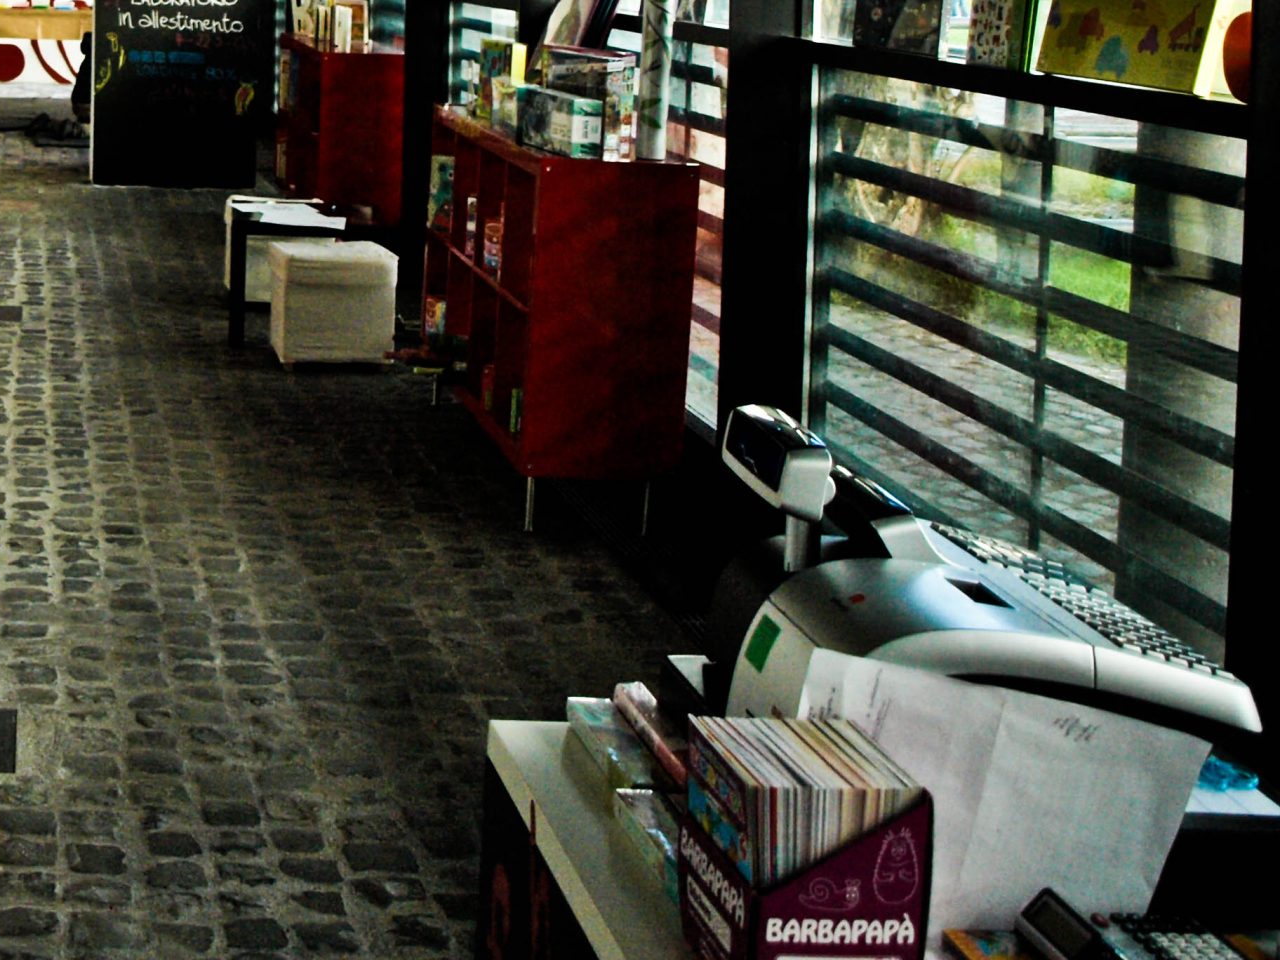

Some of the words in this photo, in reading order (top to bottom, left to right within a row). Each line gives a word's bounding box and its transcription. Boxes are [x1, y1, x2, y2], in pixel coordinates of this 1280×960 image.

[118, 7, 135, 29] in
[138, 9, 244, 33] allestimento
[765, 912, 916, 945] BARBAPAPÀ
